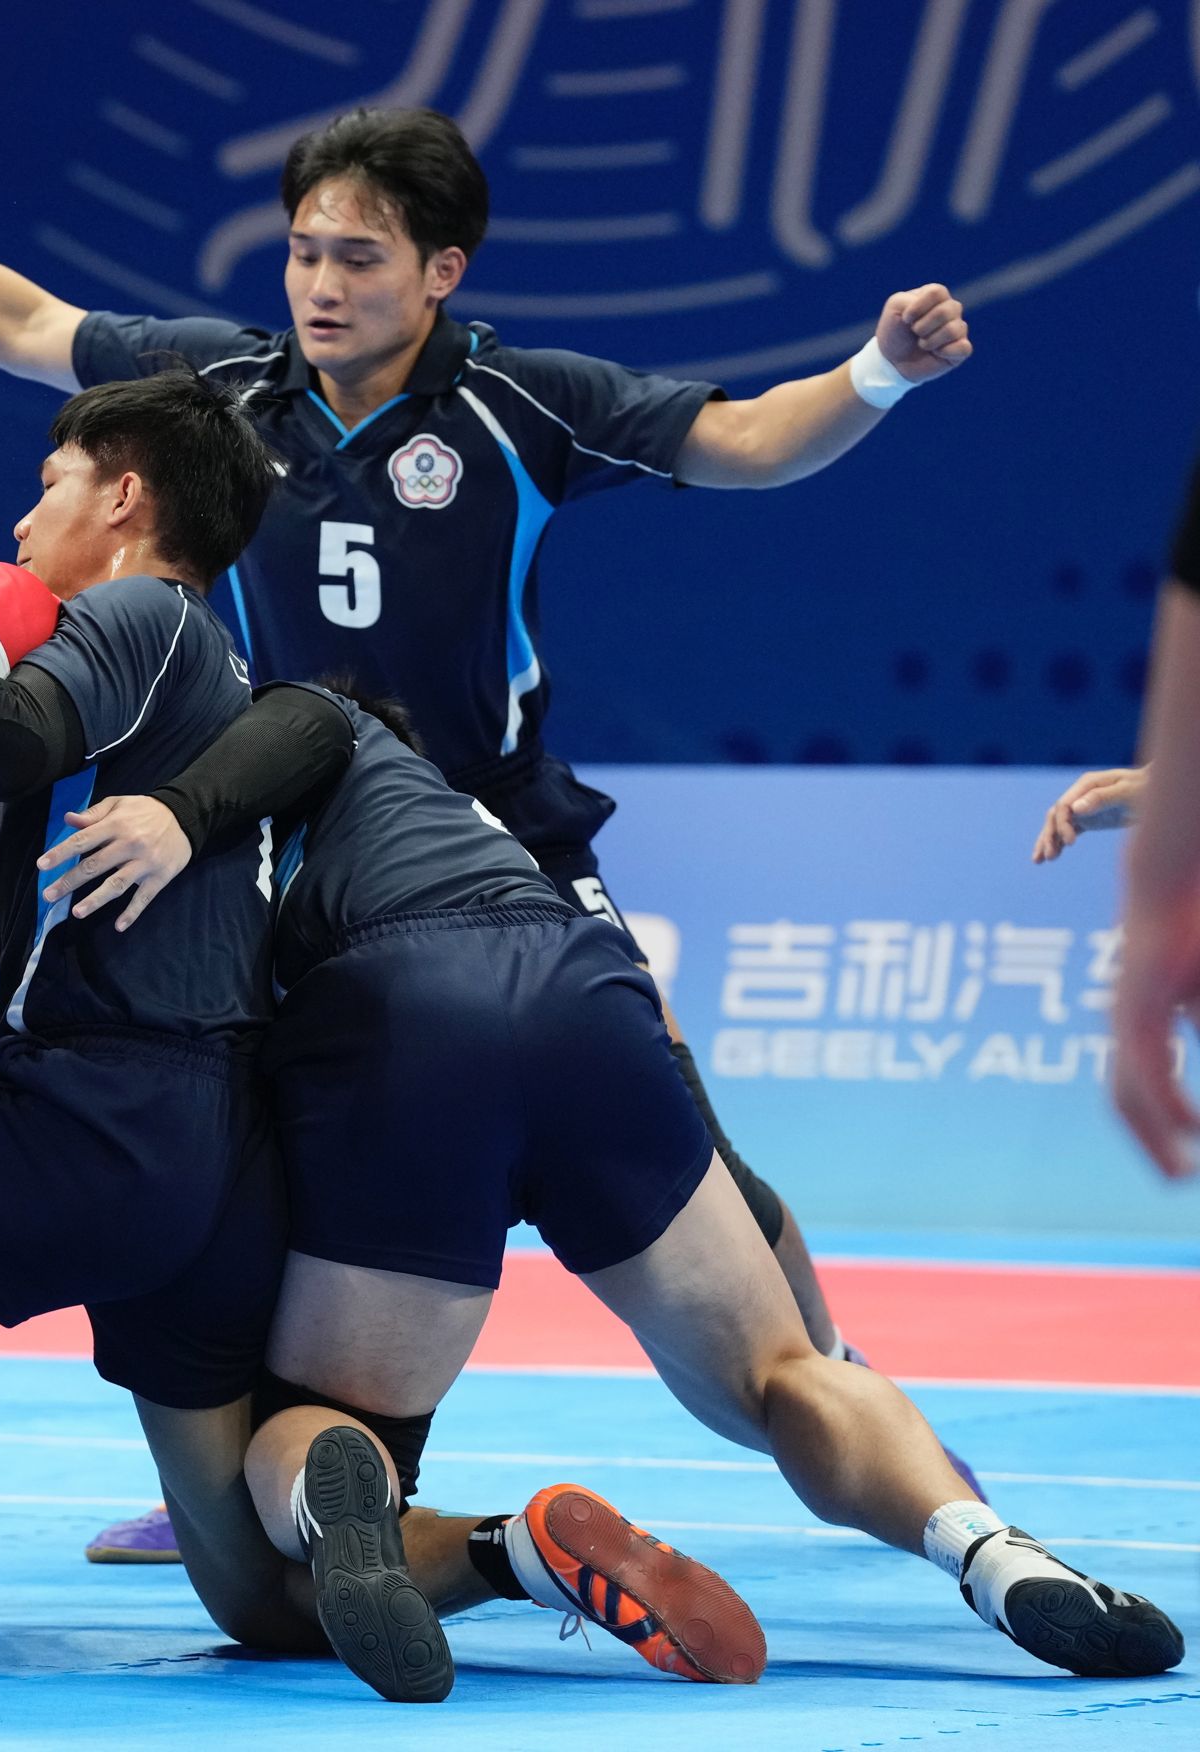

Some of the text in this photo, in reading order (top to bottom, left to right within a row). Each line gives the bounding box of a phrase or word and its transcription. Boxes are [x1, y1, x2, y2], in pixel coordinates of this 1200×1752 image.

[318, 520, 382, 630] 5
[711, 1027, 1186, 1084] GEELY AUT
